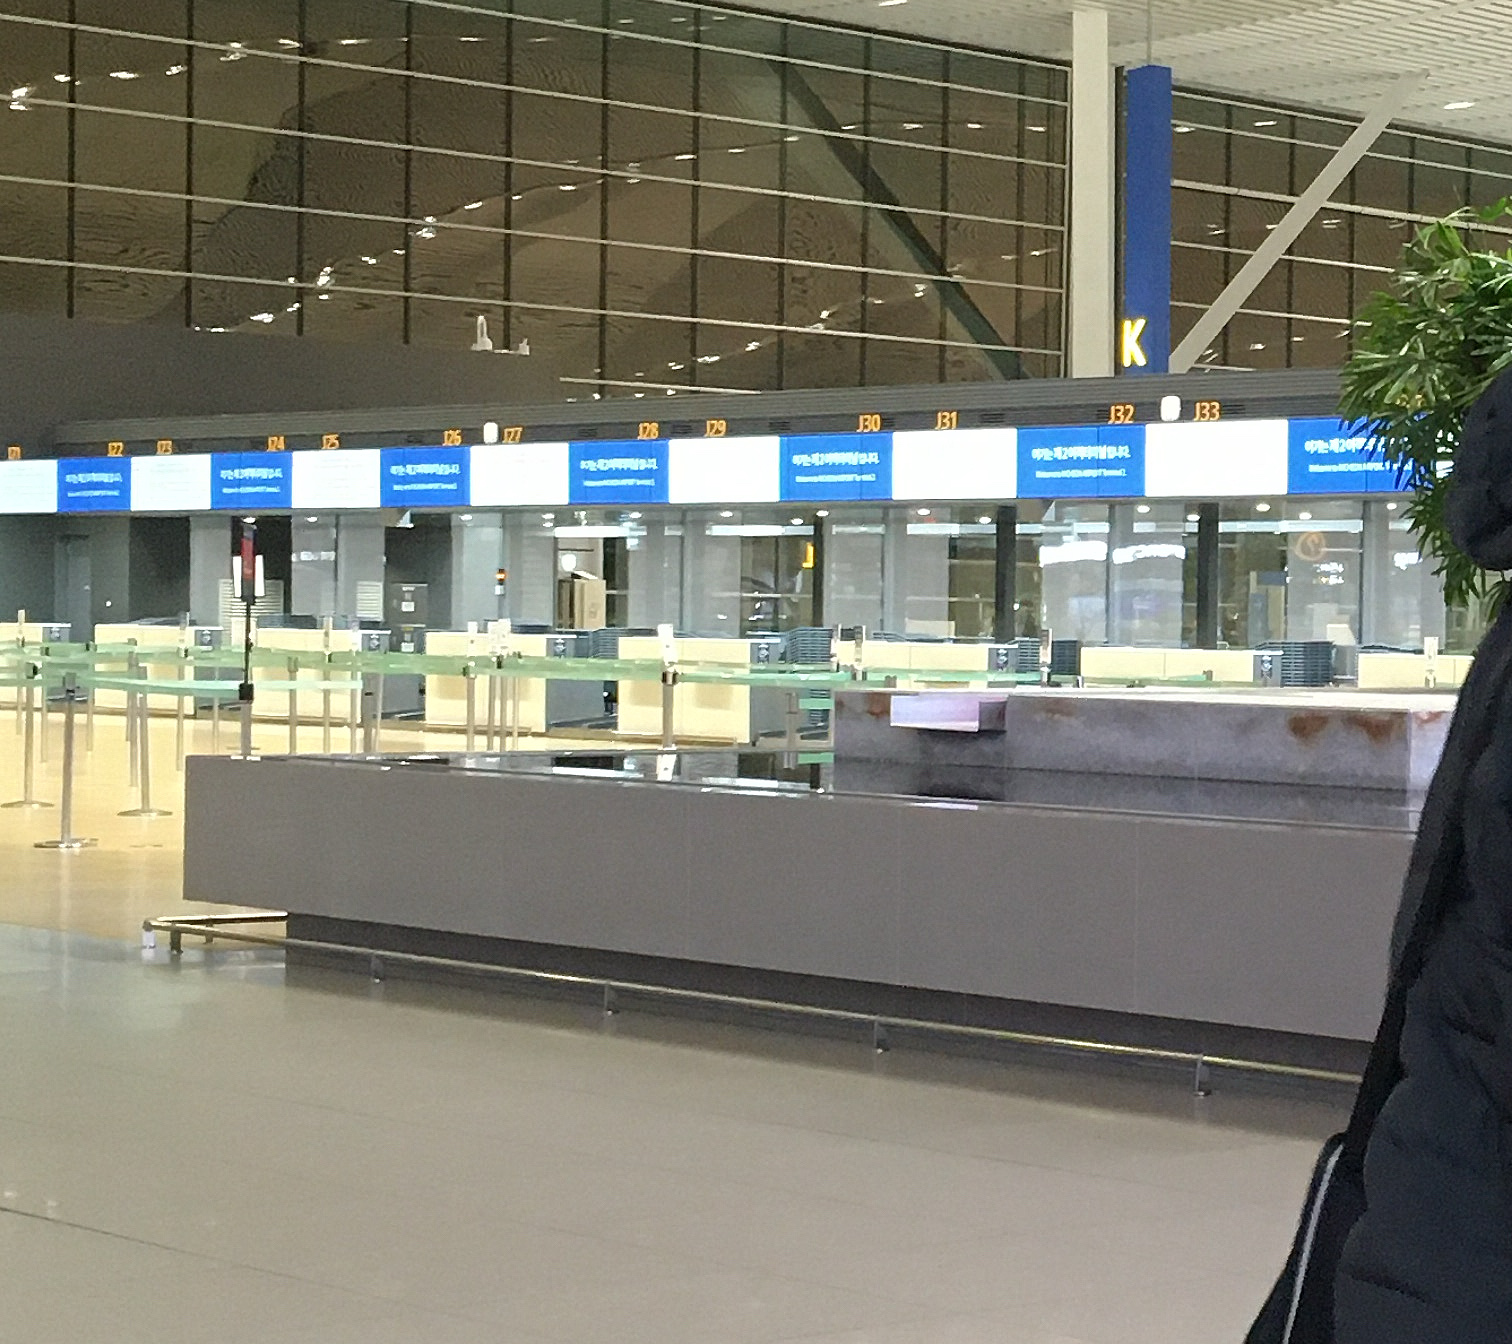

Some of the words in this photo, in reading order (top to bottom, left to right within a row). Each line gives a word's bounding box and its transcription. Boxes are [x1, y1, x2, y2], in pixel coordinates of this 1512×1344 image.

[1122, 318, 1148, 367] K
[935, 410, 959, 430] J31
[1108, 403, 1135, 424] J32
[1193, 400, 1221, 422] J33
[637, 422, 659, 440] J28
[704, 419, 727, 437] J29
[856, 413, 881, 432] J30
[266, 435, 285, 451] J24
[442, 429, 463, 446] J26
[502, 426, 523, 443] J27
